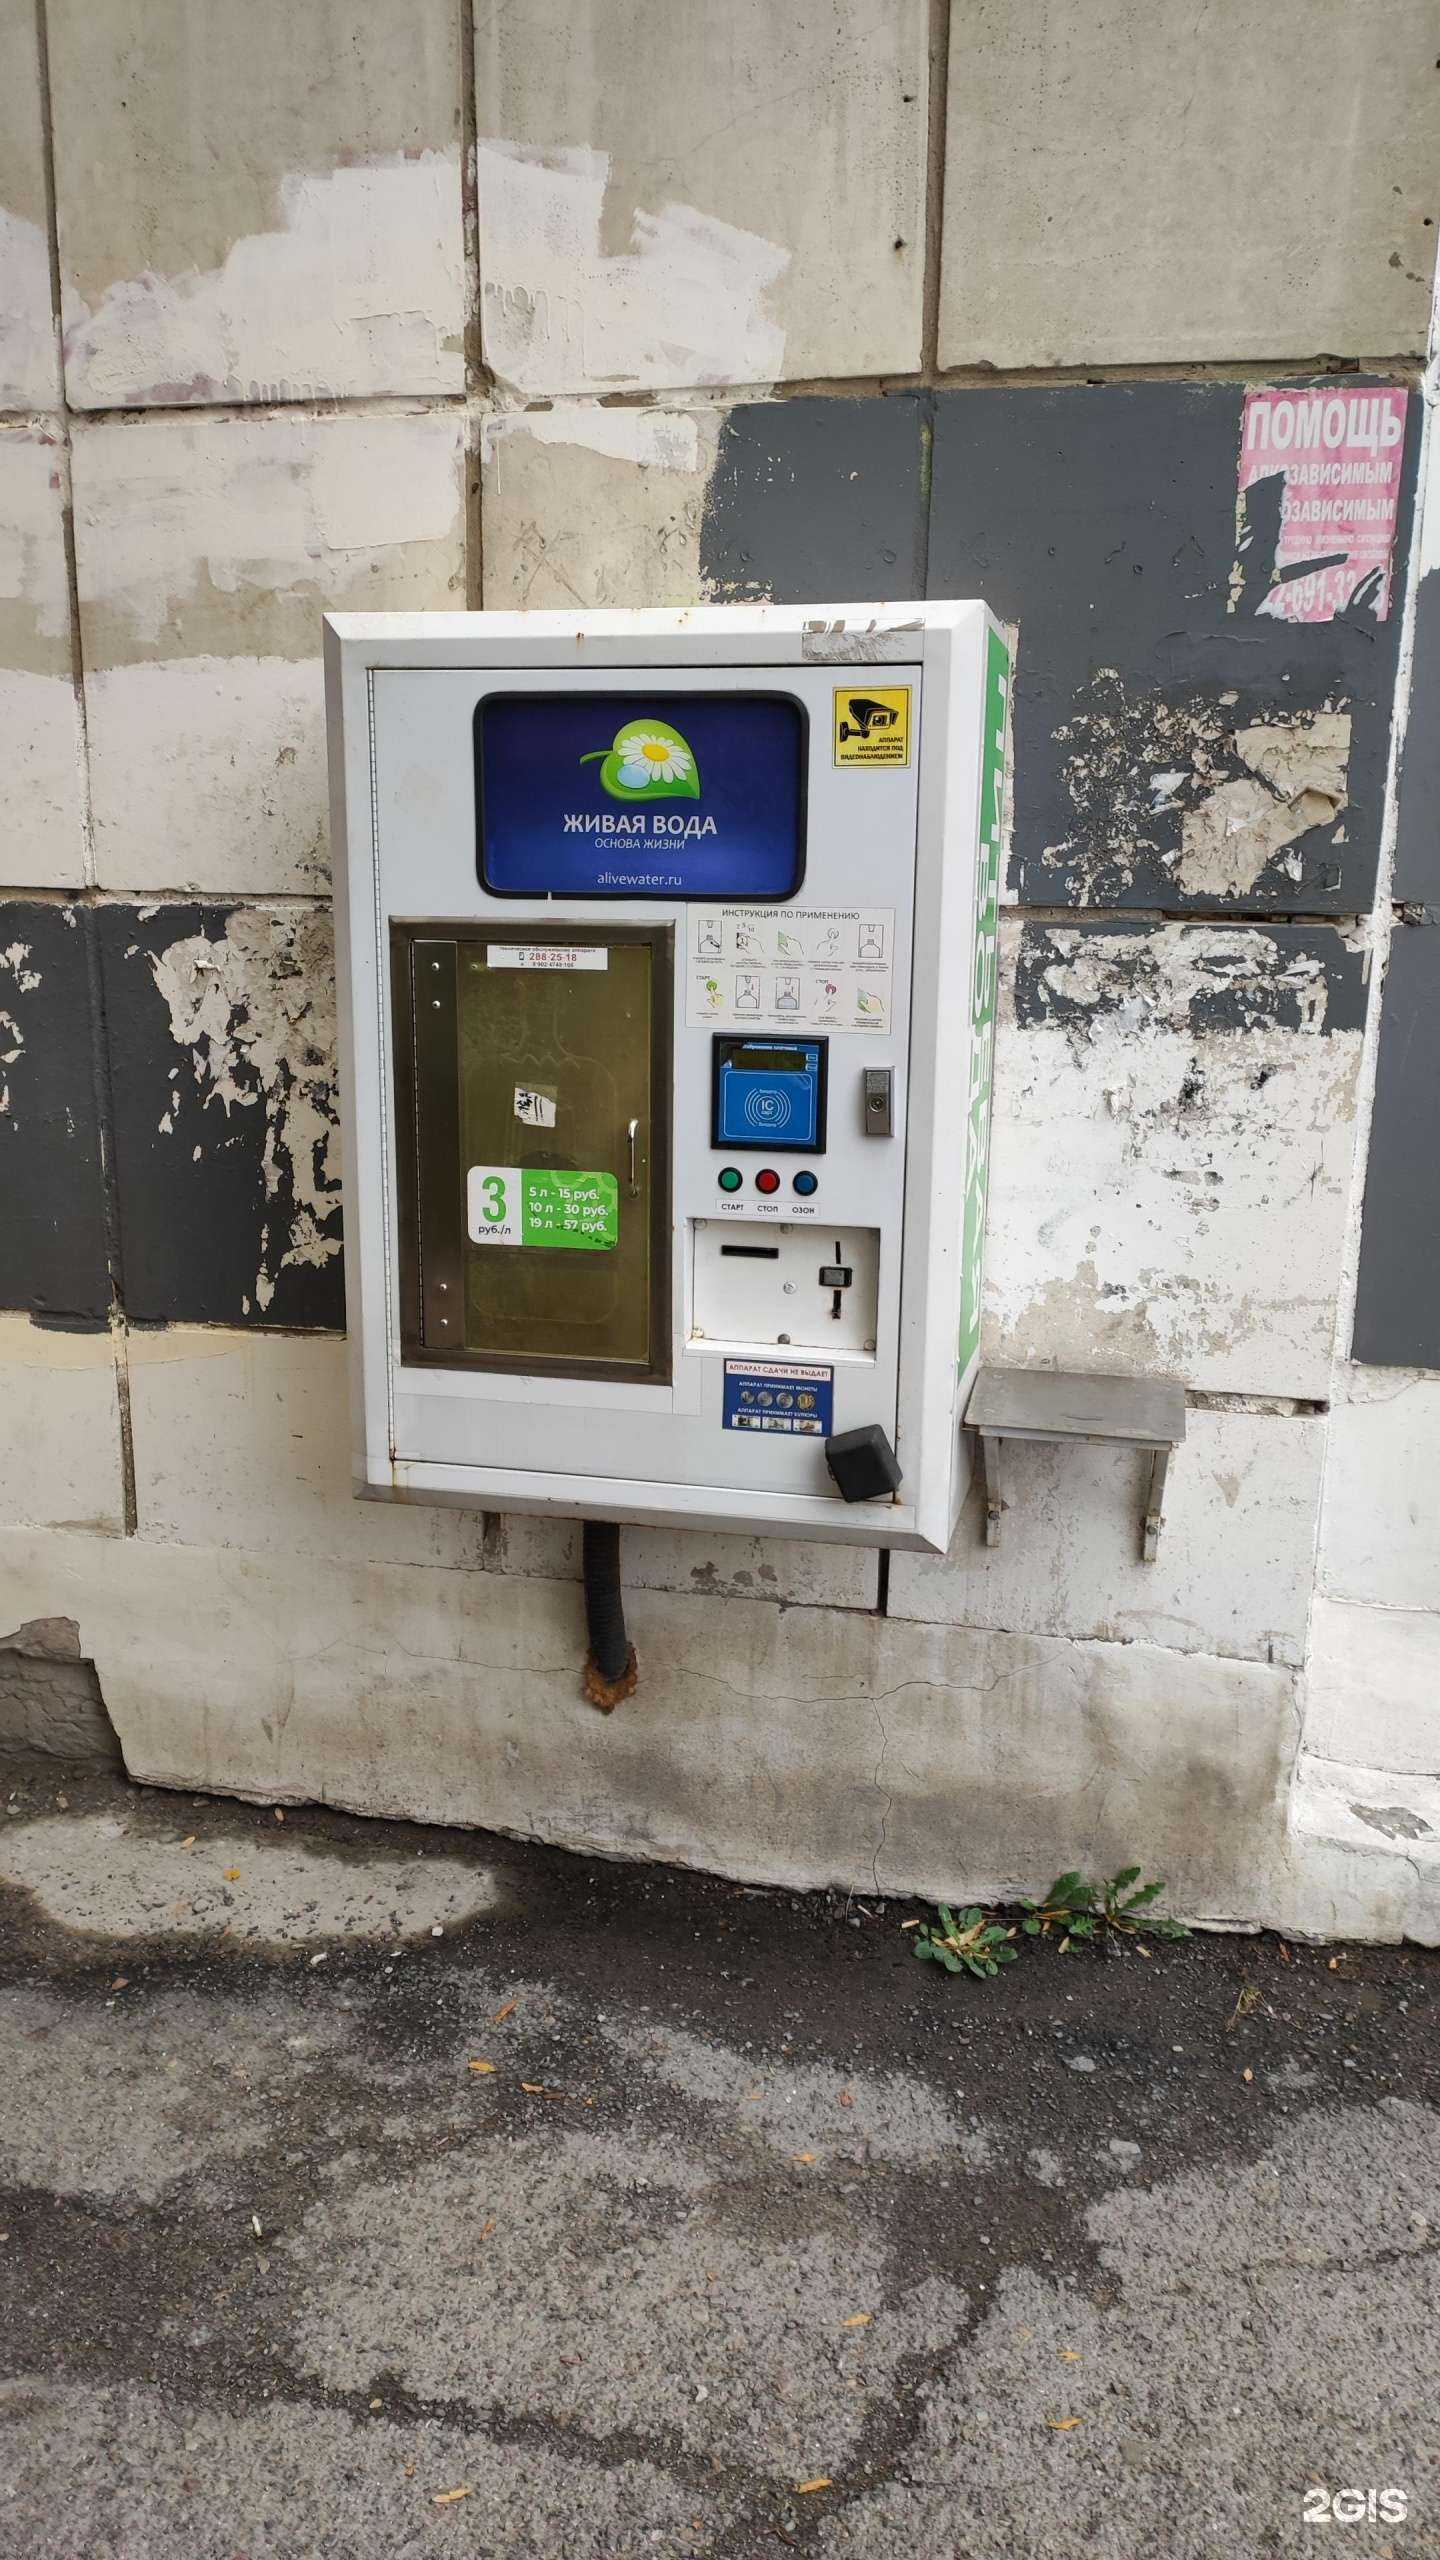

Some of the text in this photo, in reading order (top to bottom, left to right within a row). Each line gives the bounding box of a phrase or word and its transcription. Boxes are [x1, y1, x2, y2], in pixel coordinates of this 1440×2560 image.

[1247, 399, 1402, 457] ПОМОЩЬ
[1281, 499, 1394, 521] ОЗАВИСИМЫМ
[563, 814, 718, 839] ЖИВАЯ ВОДА
[595, 838, 686, 850] ОСНОВА ЖИЗНИ
[597, 872, 682, 886] alivewater.ru
[722, 909, 779, 919] ИНСТРУКЦИЯ
[796, 911, 860, 920] ПРИМЕНЕНИЮ
[529, 952, 577, 962] 288-25-18
[968, 673, 1007, 1335] ПИТЬЕВАЯ
[966, 842, 990, 1200] ВОДА
[761, 1099, 774, 1111] IC
[482, 1175, 507, 1223] 3
[529, 1187, 537, 1197] 5
[539, 1189, 548, 1198] л
[559, 1188, 571, 1198] 15
[573, 1189, 600, 1201] руб.
[529, 1202, 542, 1212] 10
[545, 1204, 553, 1213] л
[563, 1204, 580, 1214] 30
[583, 1205, 608, 1217] руб.
[721, 1203, 744, 1211] СТАРТ
[792, 1206, 815, 1214] ОЗОН
[478, 1225, 512, 1235] руб./л
[529, 1217, 541, 1228] 19
[544, 1220, 553, 1228] л
[563, 1220, 578, 1230] 57
[581, 1221, 607, 1233] руб.
[729, 1364, 761, 1372] АППАРАТ
[801, 1370, 829, 1378] ВЫДАЕТ
